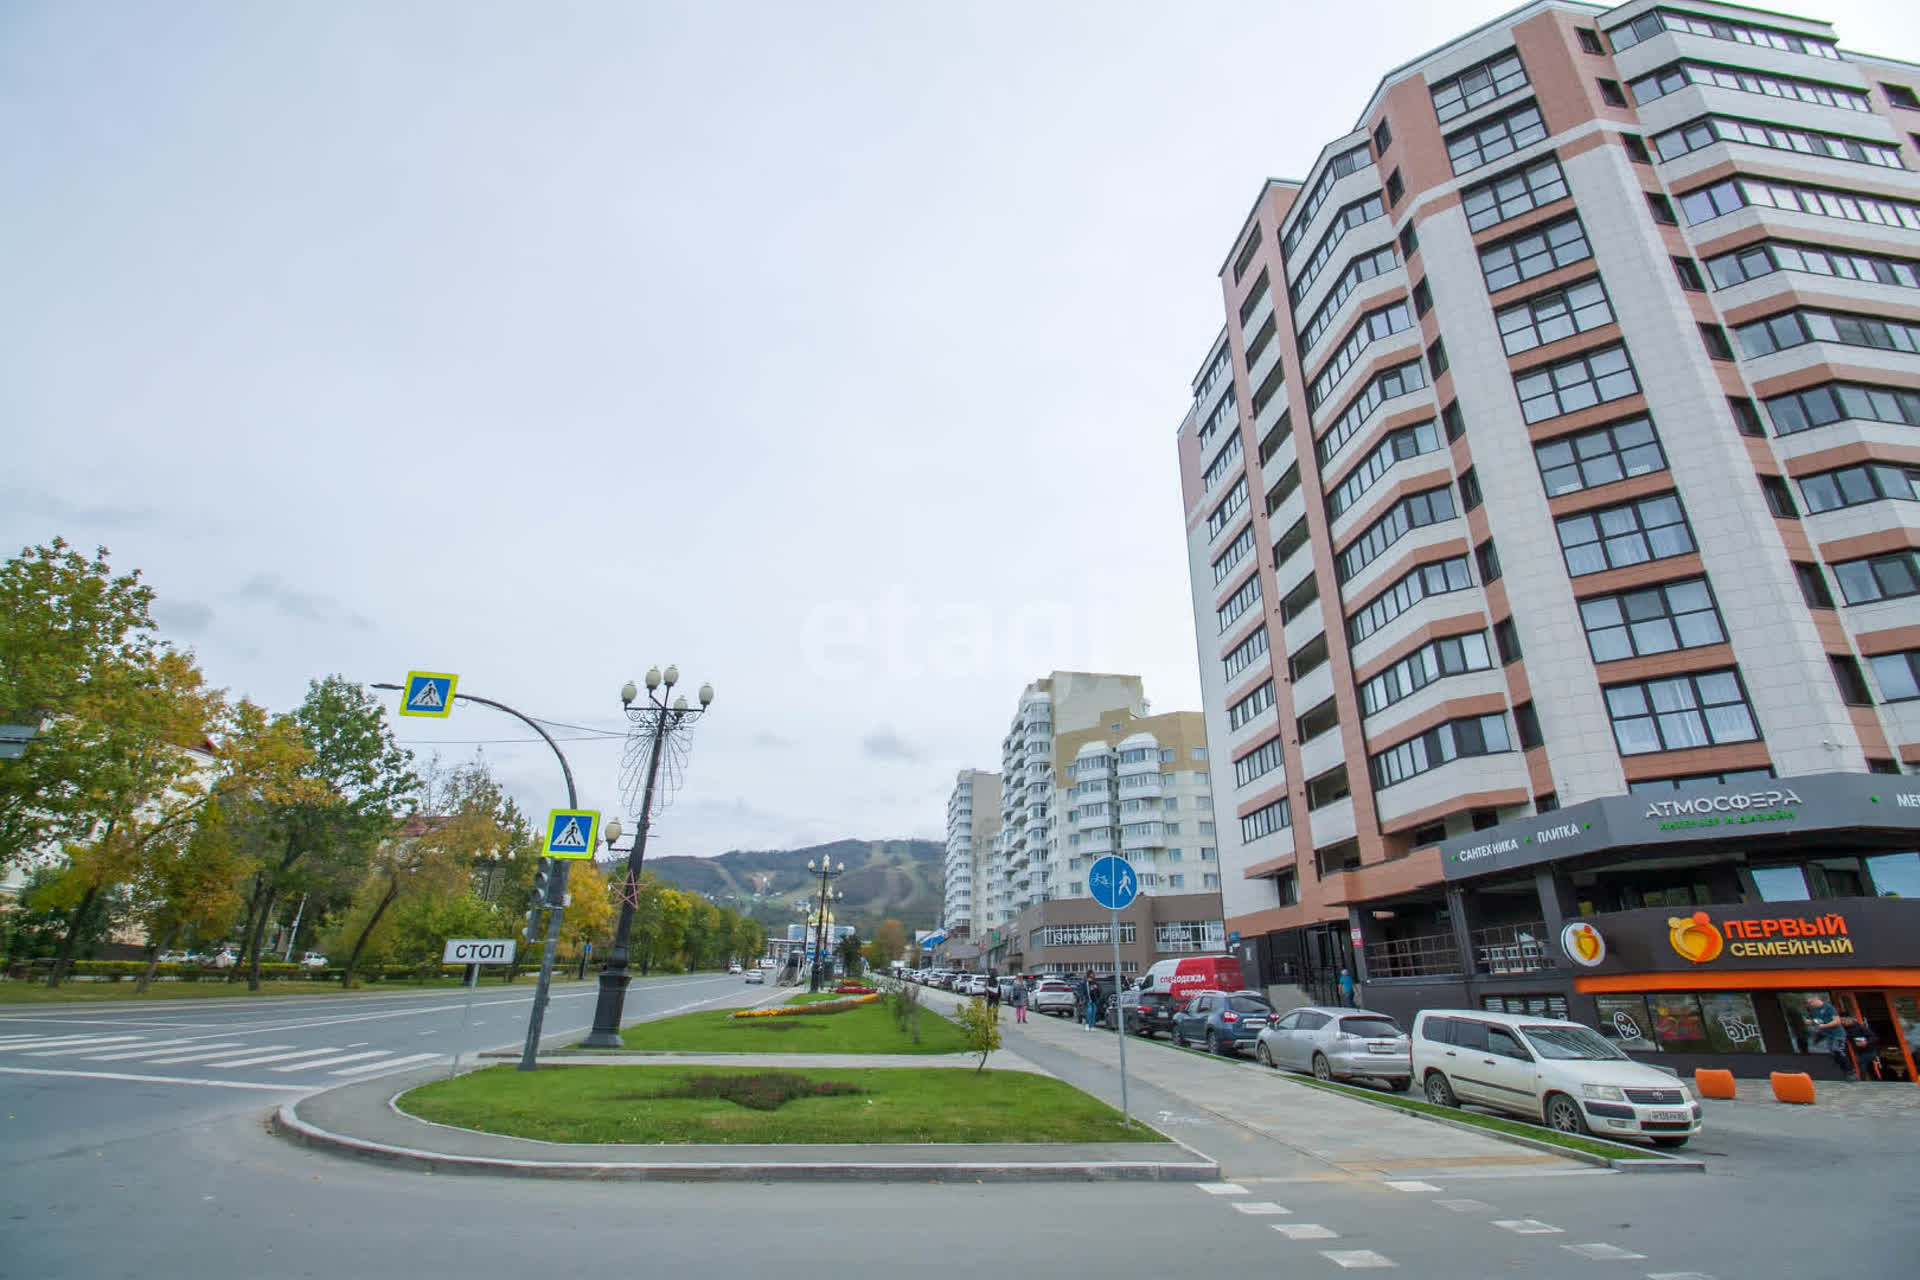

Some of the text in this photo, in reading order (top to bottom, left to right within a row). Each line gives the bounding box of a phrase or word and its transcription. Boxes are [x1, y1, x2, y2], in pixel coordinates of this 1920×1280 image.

[1645, 788, 1803, 818] АТМОСФЕРА
[1896, 793, 1920, 808] МЕ
[1459, 823, 1580, 862] САНТЕХНИКА ПЛИТКА
[1722, 912, 1848, 940] ПЕРВЫЙ
[456, 944, 505, 959] СТОП
[1729, 937, 1855, 957] СЕМЕЙНЫЙ
